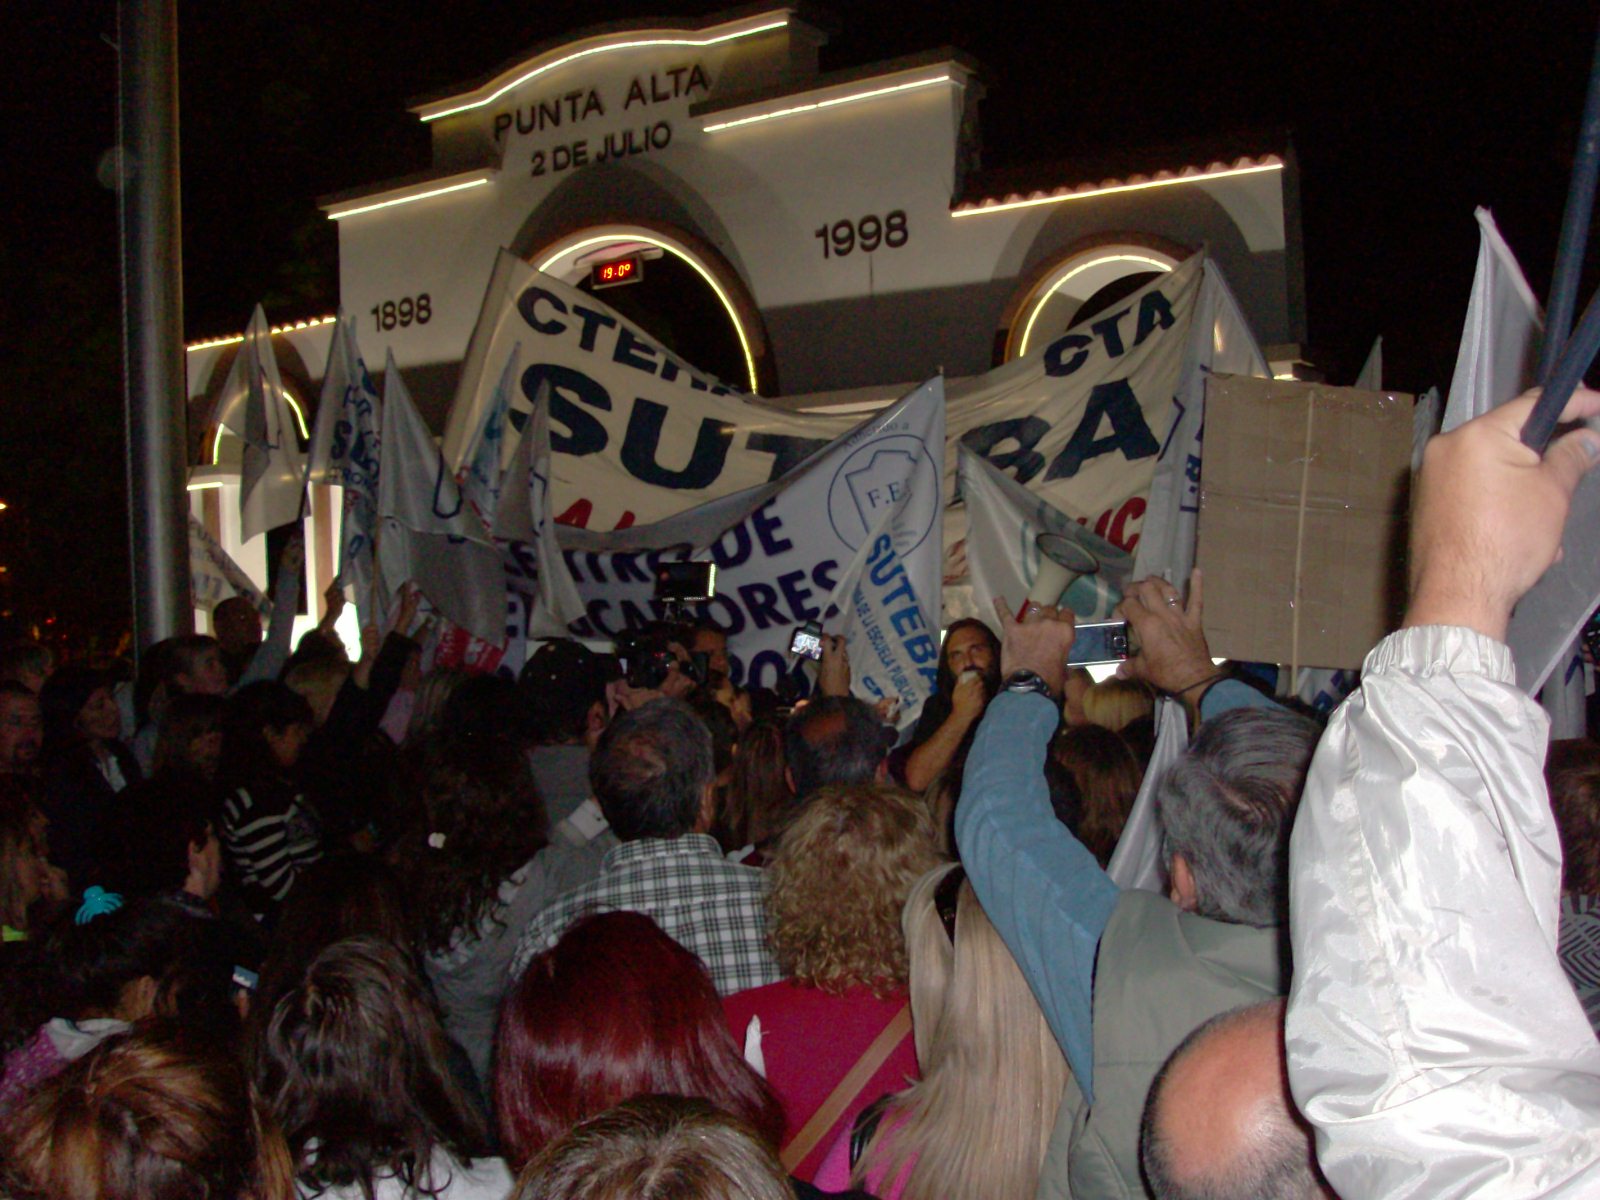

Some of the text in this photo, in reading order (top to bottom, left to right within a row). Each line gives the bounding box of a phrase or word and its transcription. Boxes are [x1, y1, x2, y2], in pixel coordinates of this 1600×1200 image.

[493, 64, 709, 143] PUNTA ALTA
[531, 120, 672, 177] 2 DE JULIO
[815, 209, 909, 259] 1998
[371, 293, 432, 333] 1898
[1044, 289, 1176, 377] CTA
